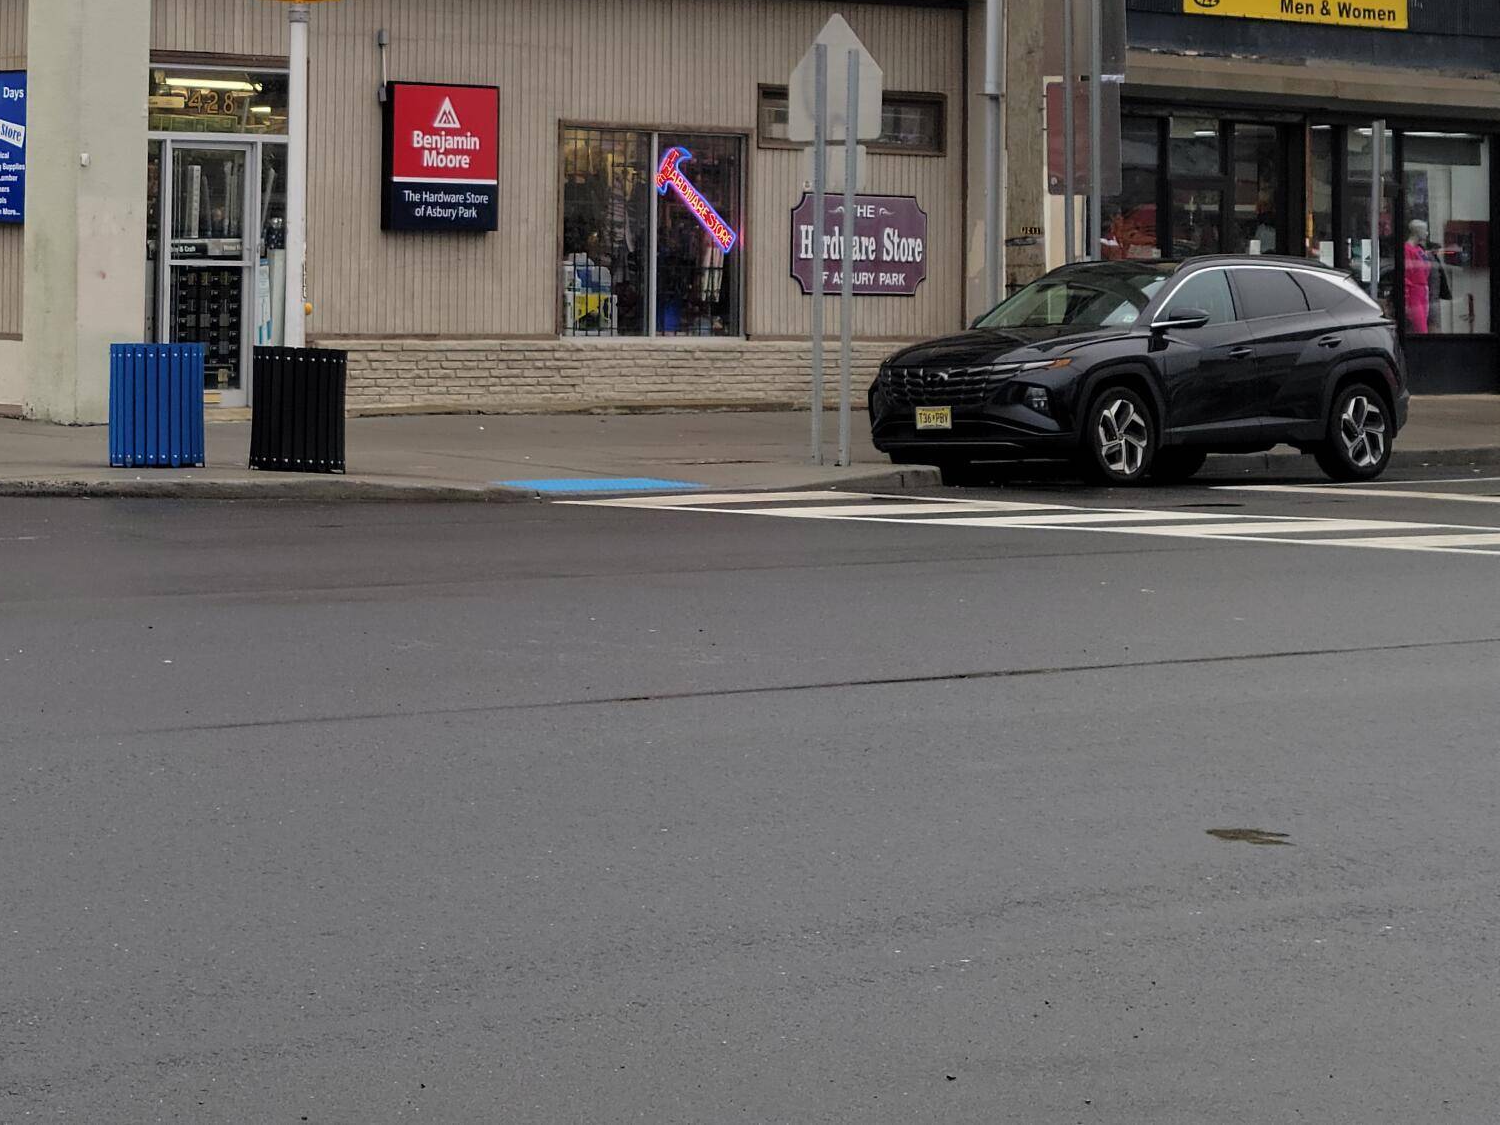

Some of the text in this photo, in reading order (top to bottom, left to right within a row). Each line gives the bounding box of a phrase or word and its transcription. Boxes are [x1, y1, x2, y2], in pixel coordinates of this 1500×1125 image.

[1320, 0, 1331, 16] &
[1337, 2, 1396, 21] Women
[3, 86, 25, 101] Days
[188, 89, 234, 114] 428
[0, 123, 22, 142] Store
[412, 130, 480, 153] Benjamin
[2, 163, 26, 172] Supplies
[423, 150, 470, 168] Moore
[403, 190, 489, 204] The Hardware Store
[414, 205, 478, 220] of Asbury Park
[853, 205, 876, 218] HE
[706, 213, 733, 249] STORE
[800, 225, 923, 263] Hrdare Store
[880, 273, 906, 286] PARK
